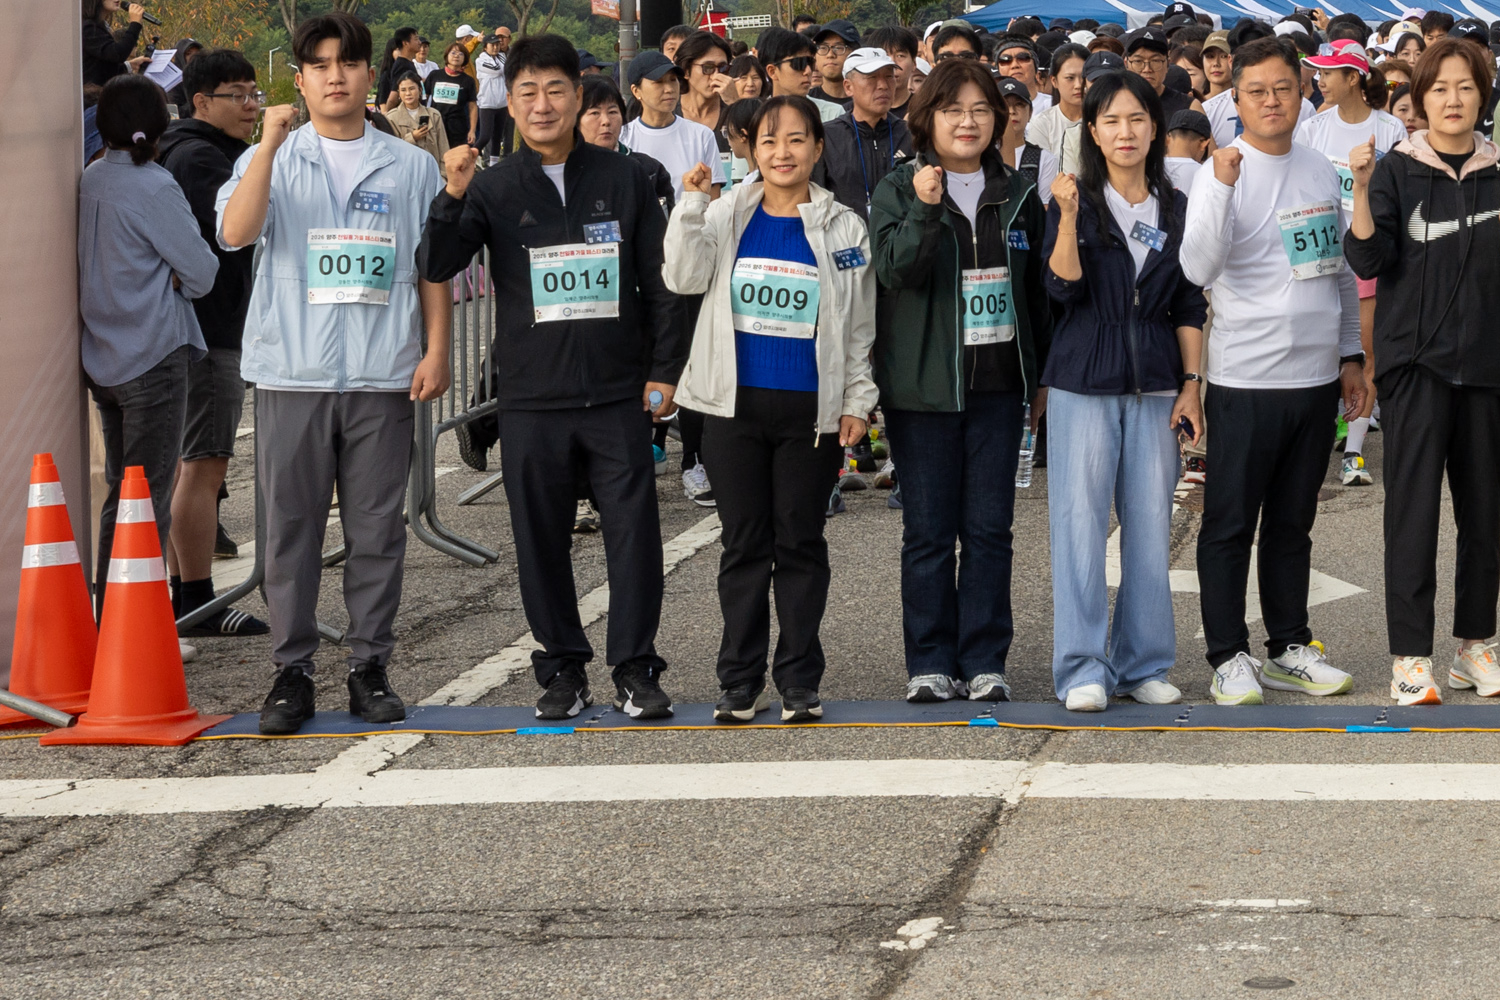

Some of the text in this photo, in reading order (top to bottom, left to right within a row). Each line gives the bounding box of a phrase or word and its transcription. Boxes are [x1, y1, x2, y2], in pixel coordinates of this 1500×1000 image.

[436, 88, 456, 97] 5519
[1293, 225, 1339, 252] 5112
[319, 255, 385, 277] 0012
[543, 268, 609, 292] 0014
[740, 283, 808, 311] 0009
